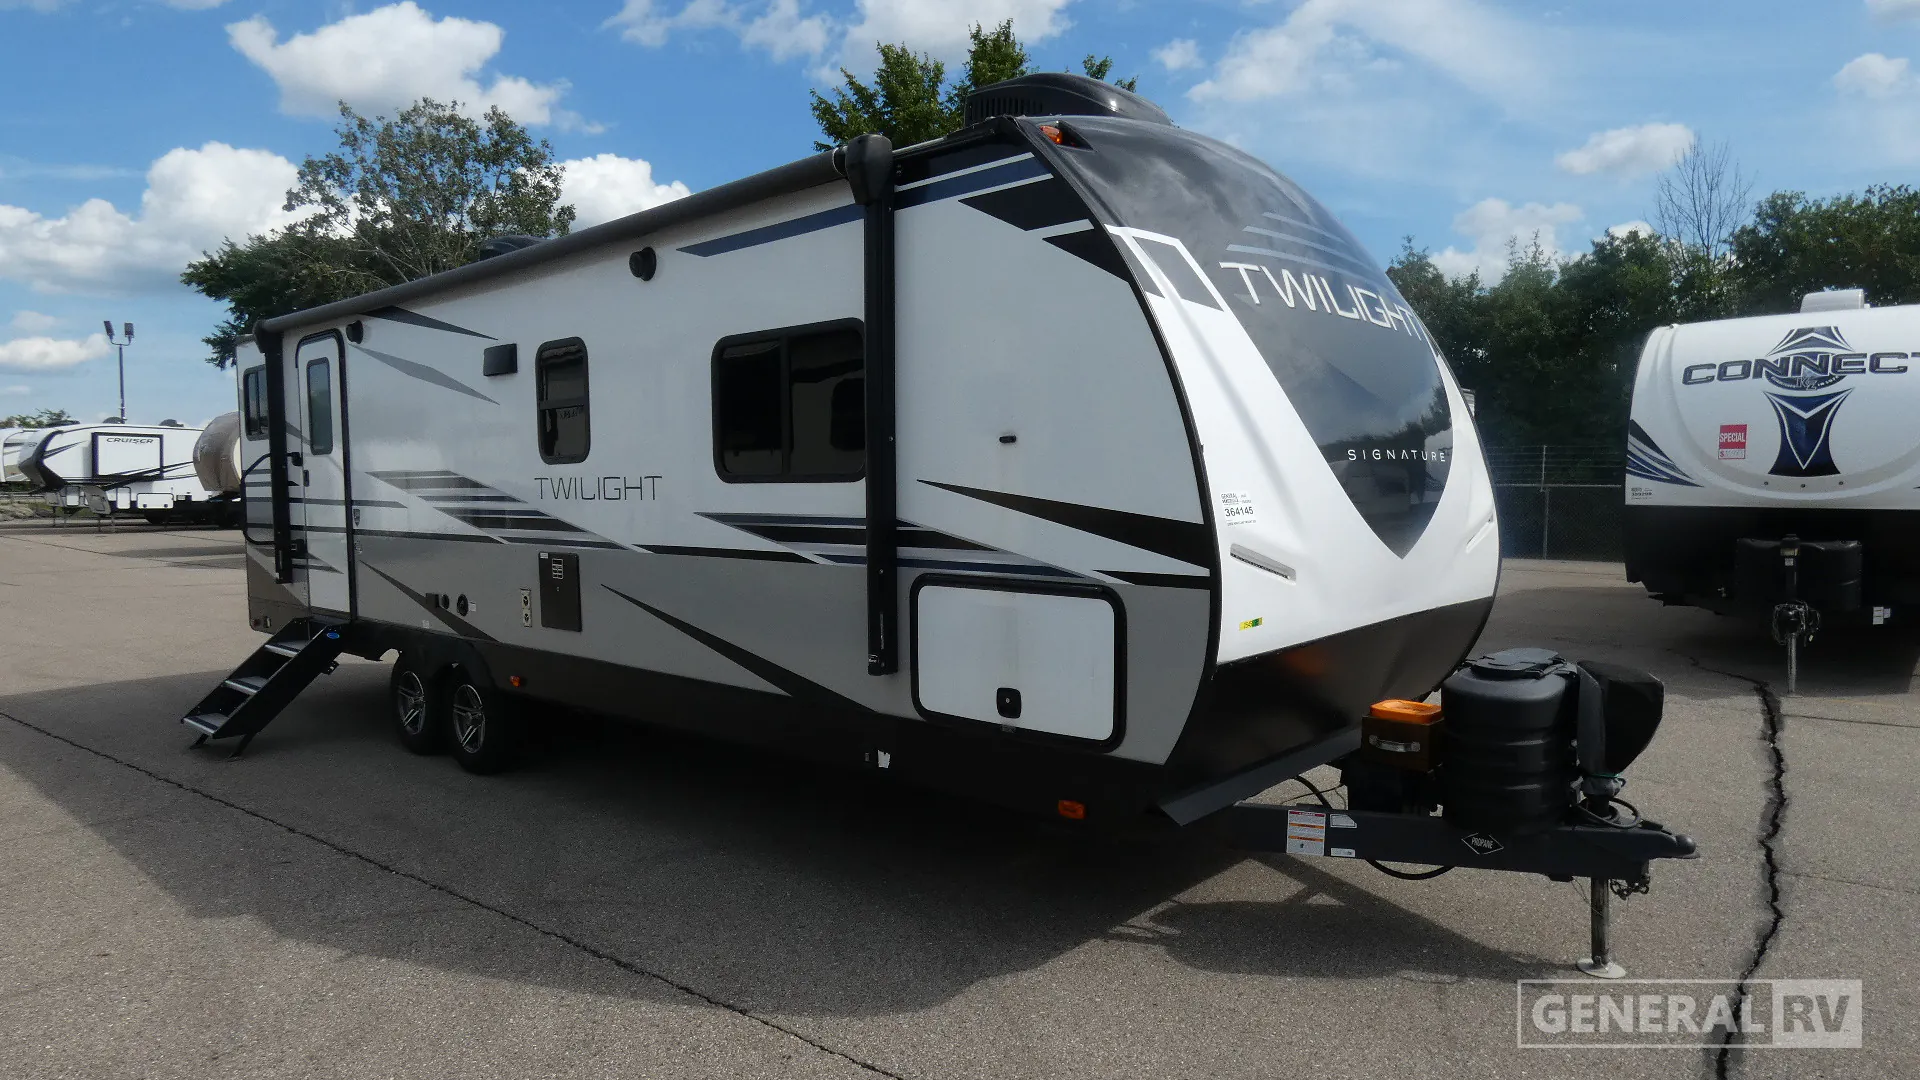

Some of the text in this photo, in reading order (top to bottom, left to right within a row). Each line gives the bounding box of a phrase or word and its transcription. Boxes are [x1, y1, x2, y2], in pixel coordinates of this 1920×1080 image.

[1219, 262, 1424, 341] TWILIGHT
[1719, 432, 1746, 443] SPECIAL
[1347, 449, 1446, 463] SIGNATURE
[534, 475, 663, 501] TWILIGHT
[1224, 506, 1254, 517] 364145
[1471, 836, 1493, 849] PROPANE
